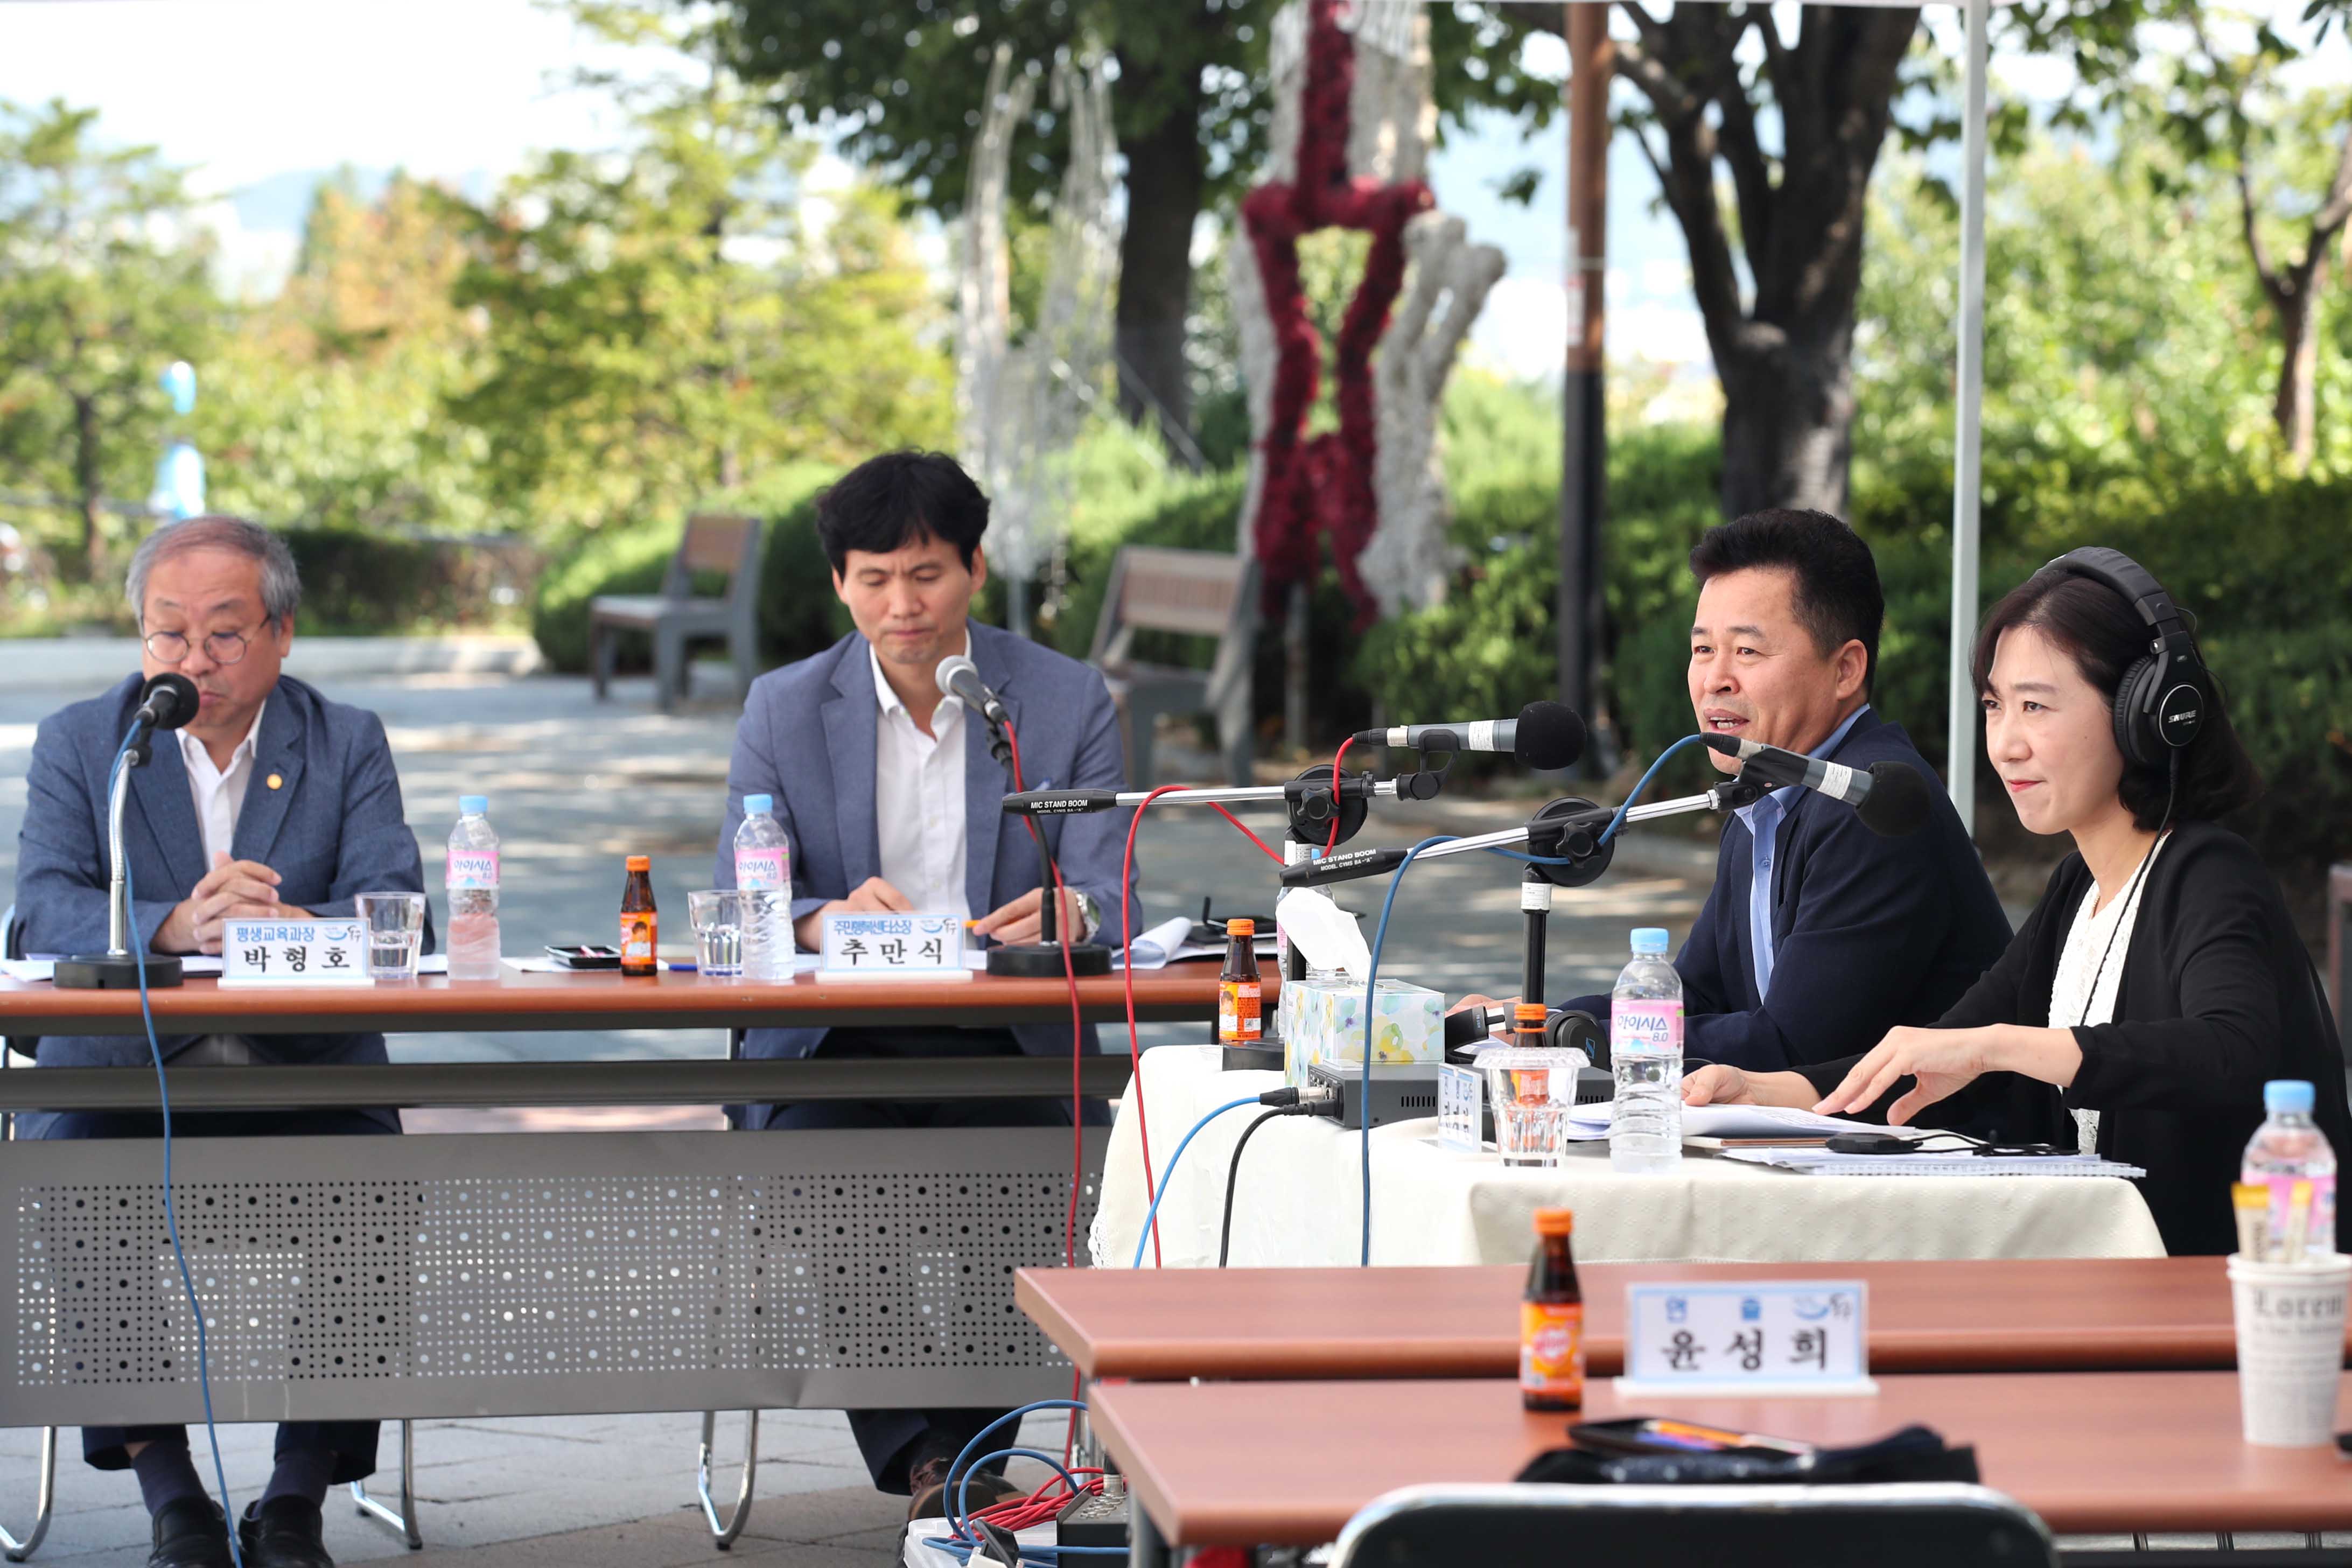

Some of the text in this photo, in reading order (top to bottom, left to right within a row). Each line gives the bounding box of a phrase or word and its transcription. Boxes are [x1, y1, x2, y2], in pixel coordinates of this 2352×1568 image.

[2168, 710, 2196, 723] SHURE
[1044, 800, 1067, 808] STAND
[1068, 799, 1088, 807] BOOM
[1313, 849, 1376, 866] MIC STAND BOOM
[236, 926, 316, 942] 평생교육과장
[1617, 1016, 1668, 1031] 아이시스
[1653, 1032, 1669, 1042] 8.0
